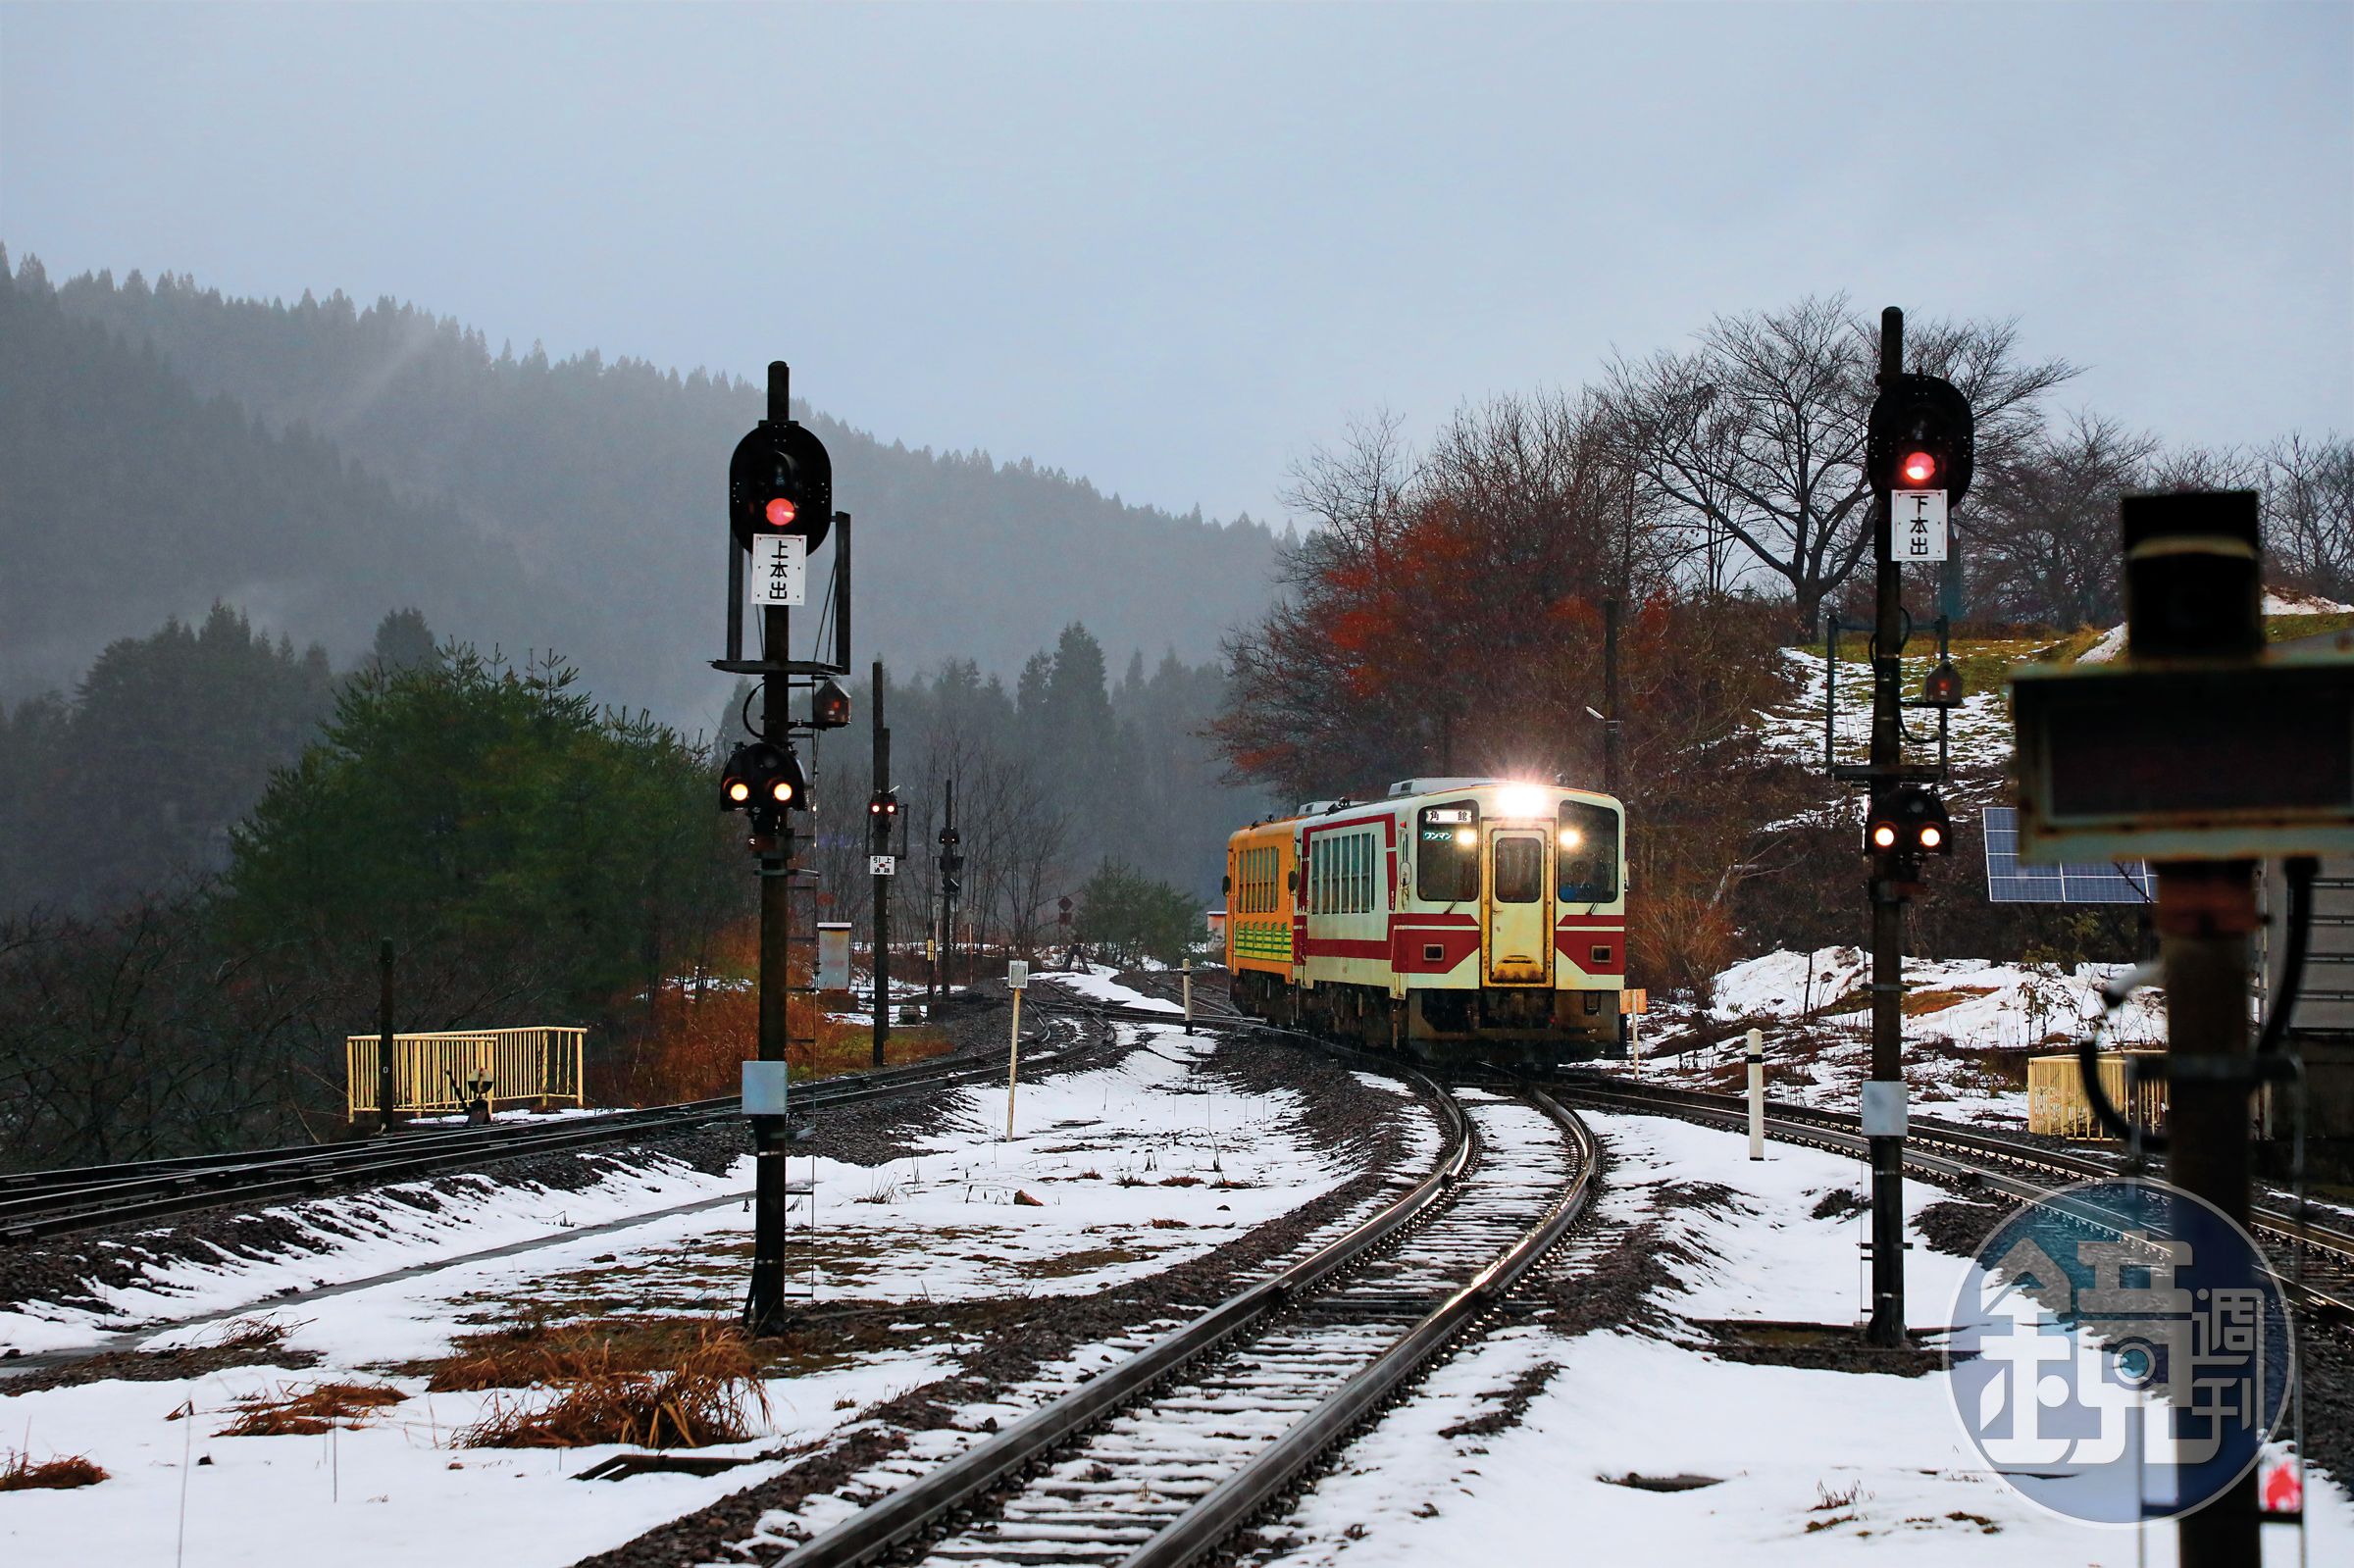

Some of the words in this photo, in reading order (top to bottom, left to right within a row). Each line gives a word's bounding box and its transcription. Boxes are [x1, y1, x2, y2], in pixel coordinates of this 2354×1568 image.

[1910, 495, 1928, 555] 下本出
[769, 540, 789, 599] 上本出
